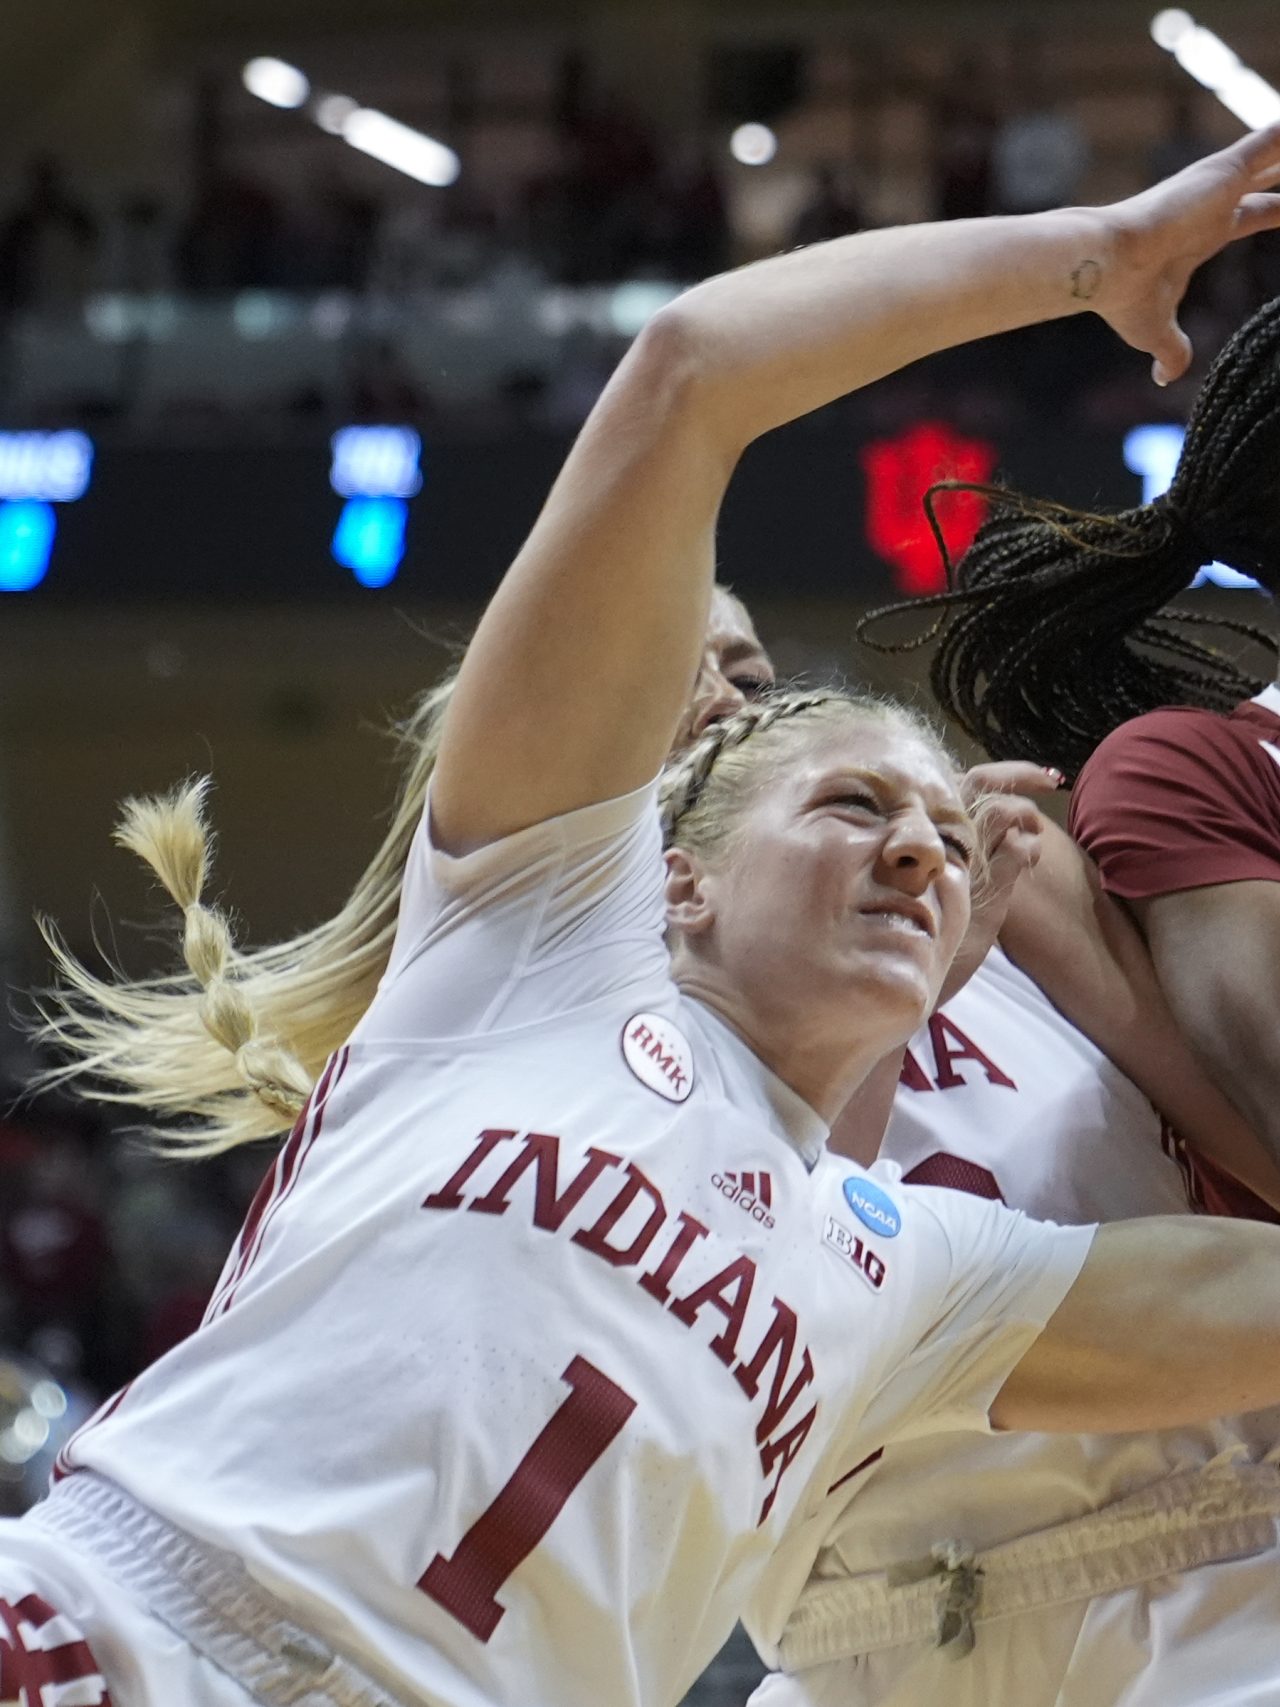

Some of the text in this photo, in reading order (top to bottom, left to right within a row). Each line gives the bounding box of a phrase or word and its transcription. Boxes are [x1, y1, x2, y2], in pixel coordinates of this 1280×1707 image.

[630, 1022, 688, 1094] RMK
[710, 1171, 776, 1230] adidas
[851, 1191, 898, 1232] NCAA
[421, 1128, 819, 1529] INDIANA
[416, 1354, 638, 1644] 1
